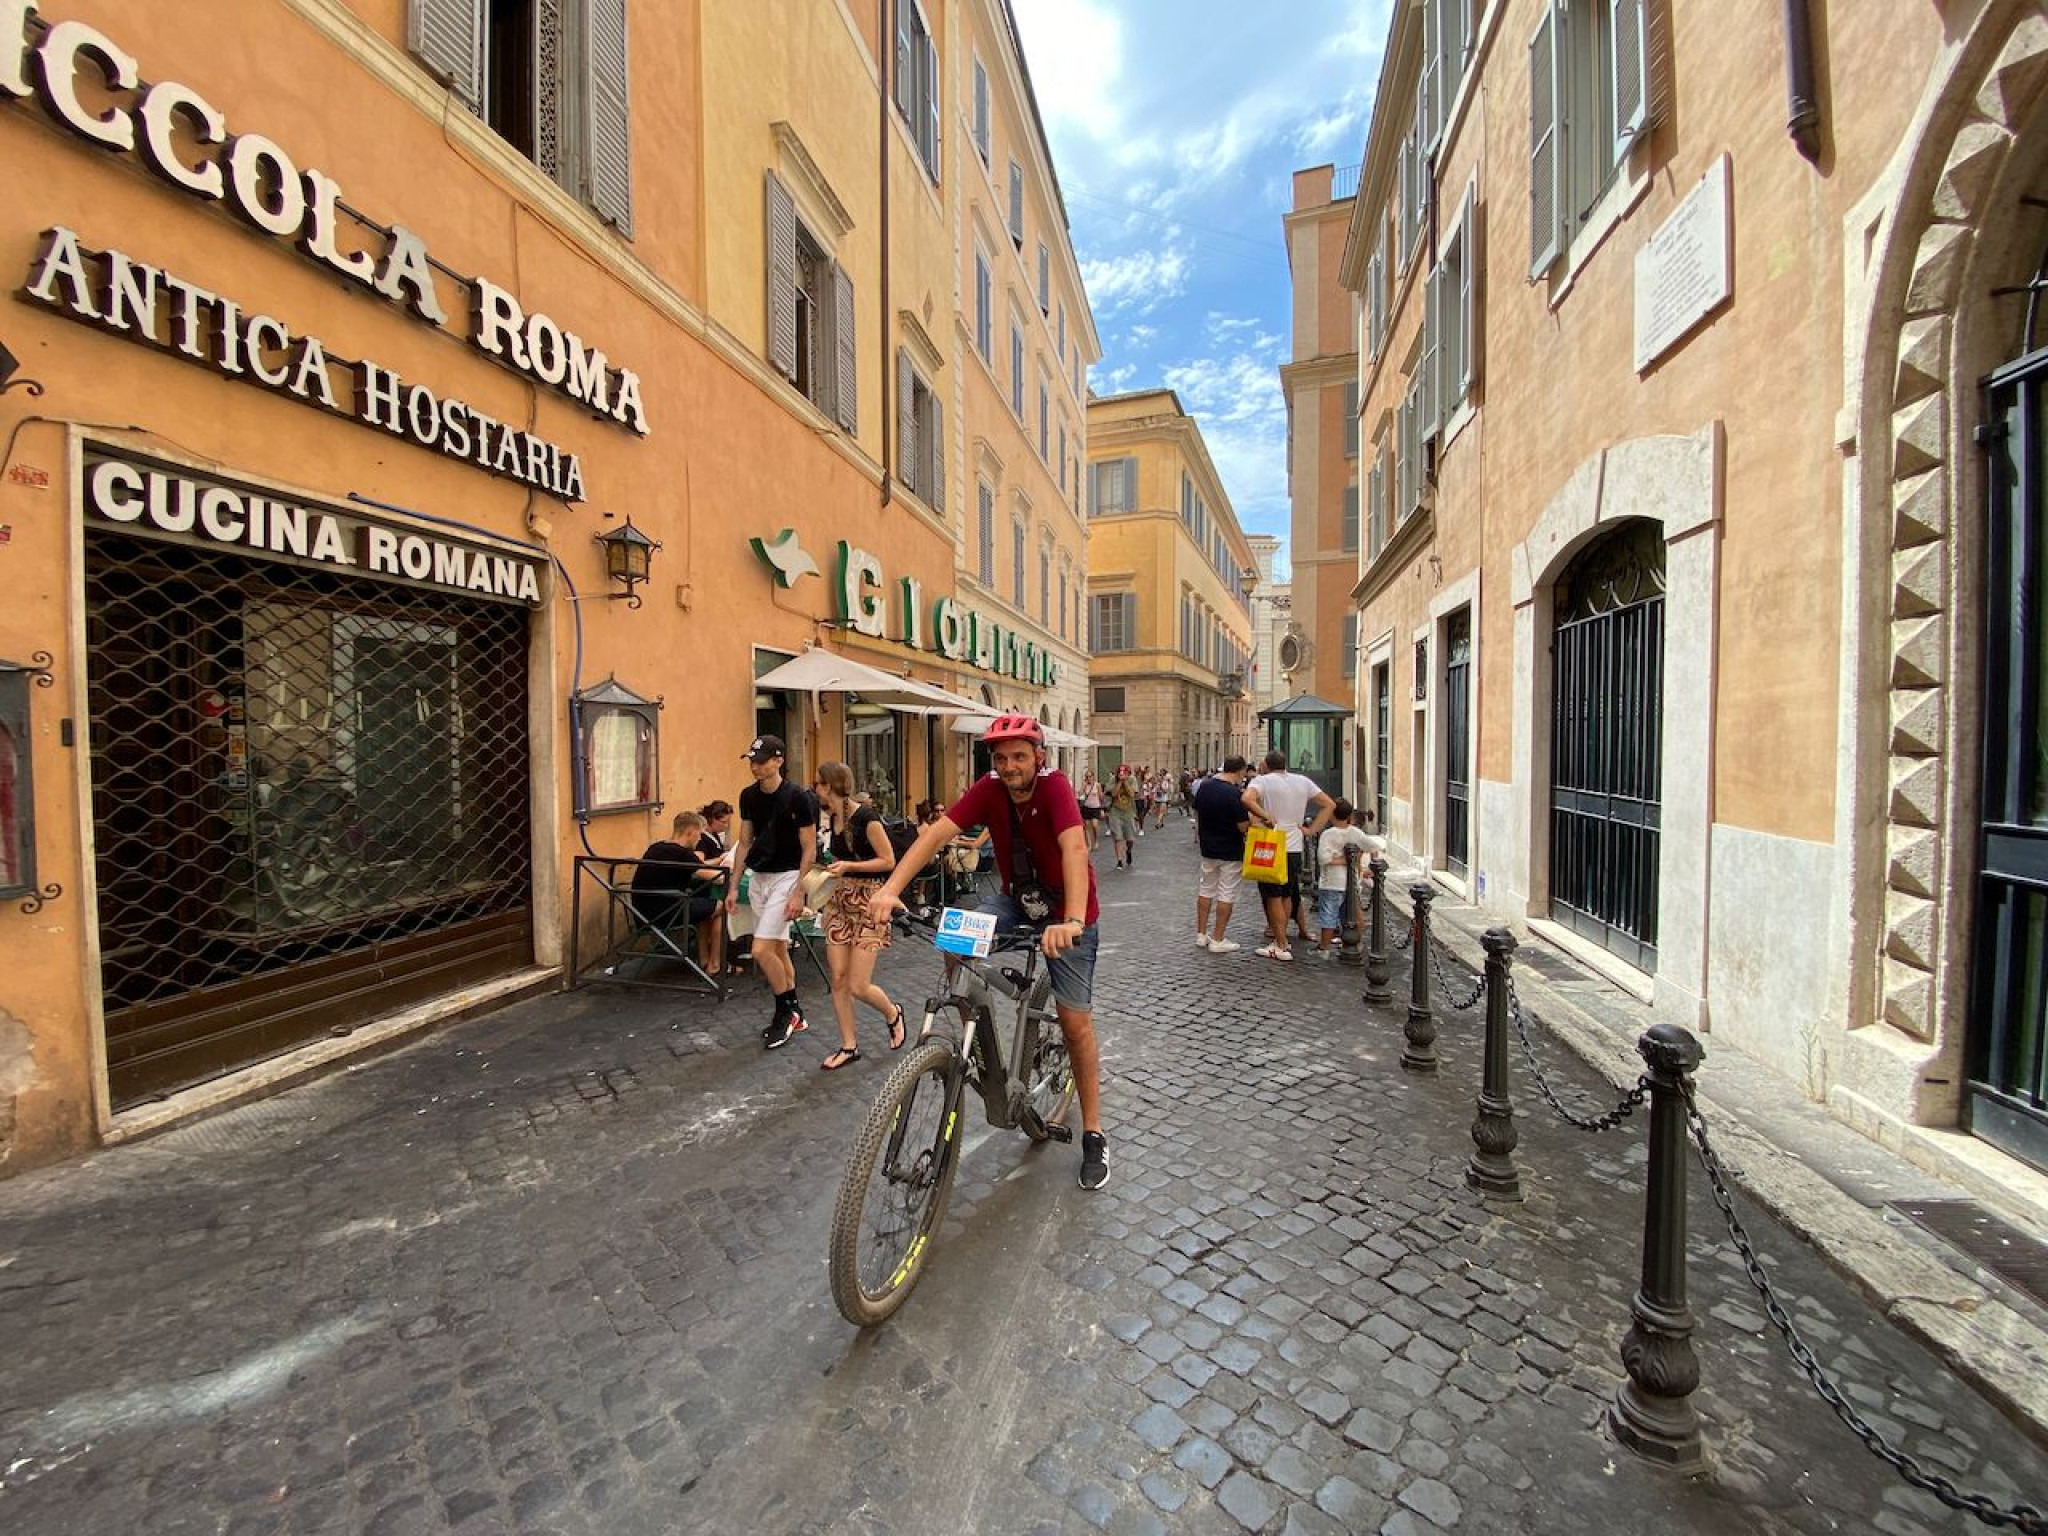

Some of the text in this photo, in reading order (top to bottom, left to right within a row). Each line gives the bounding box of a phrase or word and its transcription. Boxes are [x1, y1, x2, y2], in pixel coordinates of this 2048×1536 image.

[25, 225, 589, 503] ANTICA HOSTARIA
[476, 276, 651, 435] ROMA
[92, 461, 541, 602] CUCINA ROMANA
